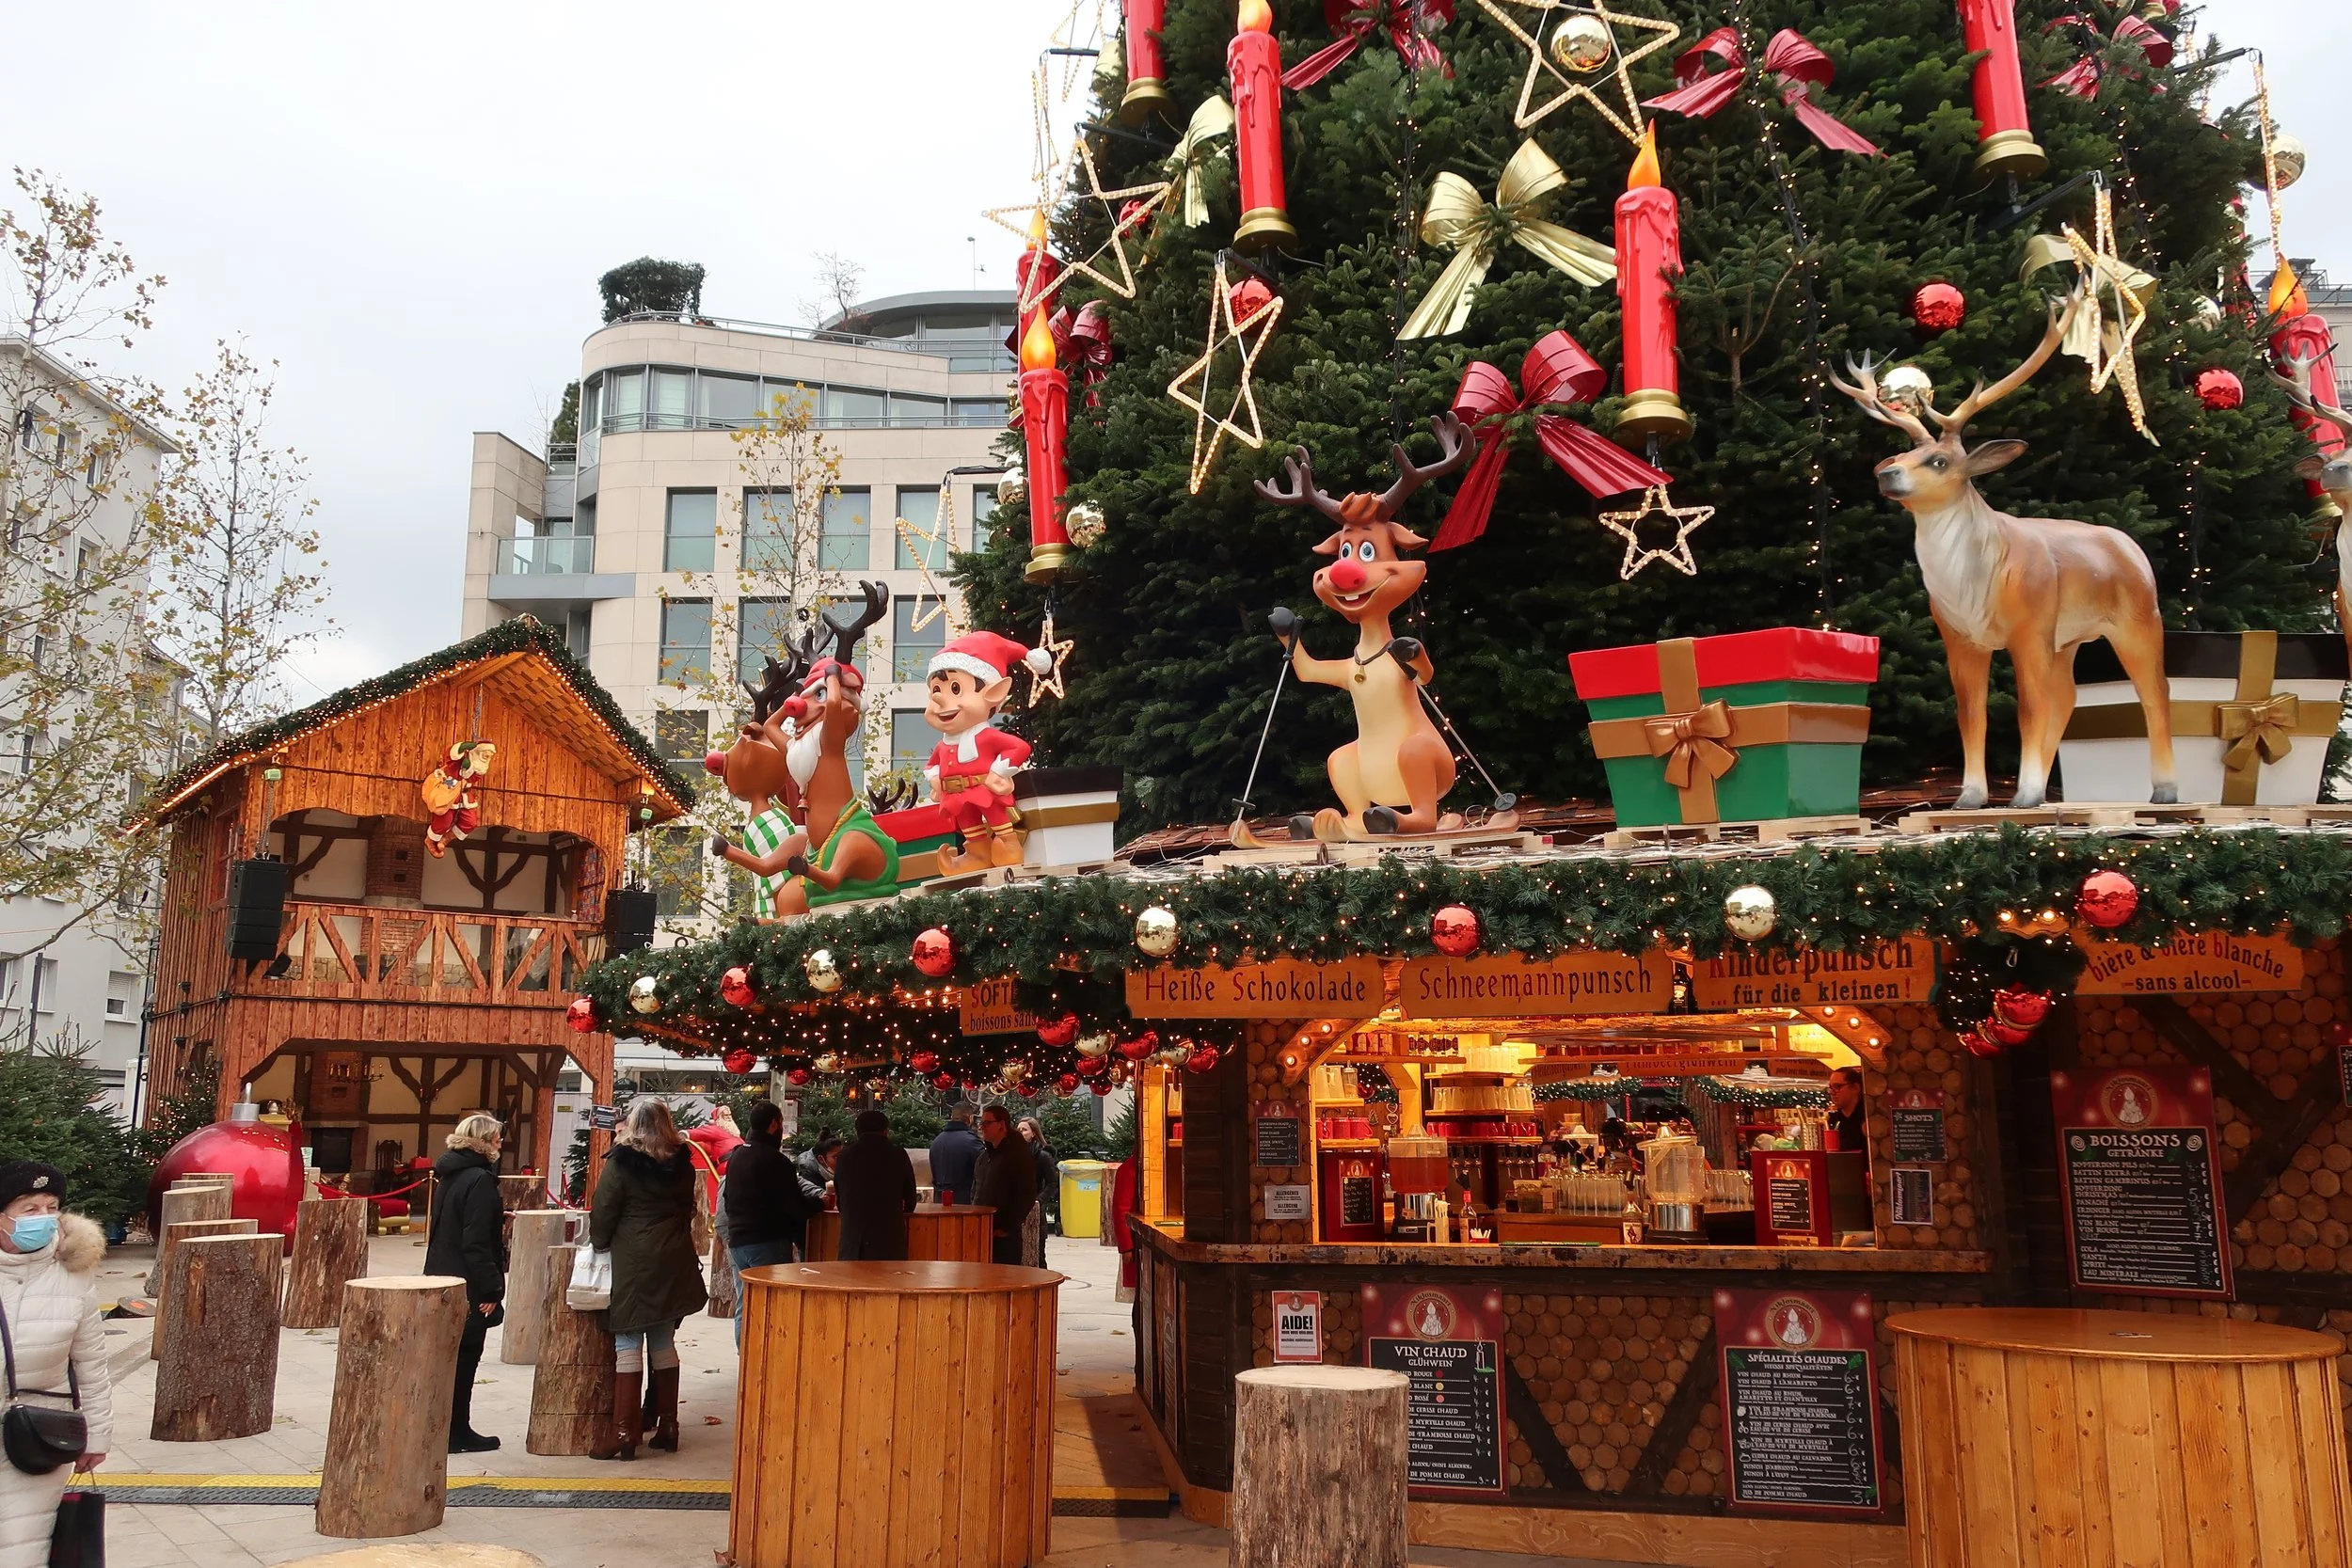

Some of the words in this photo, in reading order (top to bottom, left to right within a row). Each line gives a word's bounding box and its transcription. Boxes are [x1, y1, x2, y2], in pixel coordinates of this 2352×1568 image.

[1708, 939, 1914, 984] Kinderpunsch
[2087, 947, 2137, 982] bière
[2213, 932, 2284, 979] blanche
[1145, 970, 1216, 1002] Heiße
[1232, 970, 1366, 1002] Schokolade
[1419, 959, 1652, 1004] Schneemannpunsch
[1733, 982, 1764, 1005] für
[1771, 981, 1801, 1003] die
[1818, 979, 1900, 1003] kleinen
[2089, 1134, 2181, 1147] BOISSONS
[2107, 1147, 2164, 1157] GETRÄNKE
[1281, 1315, 1313, 1330] AIDE!
[1394, 1346, 1421, 1356] VIN
[1422, 1347, 1467, 1358] CHAUD
[1747, 1351, 1803, 1363] SPÉCIALITÉS
[1804, 1355, 1848, 1365] CHAUDES
[1407, 1357, 1454, 1368] GLÜHWEIN
